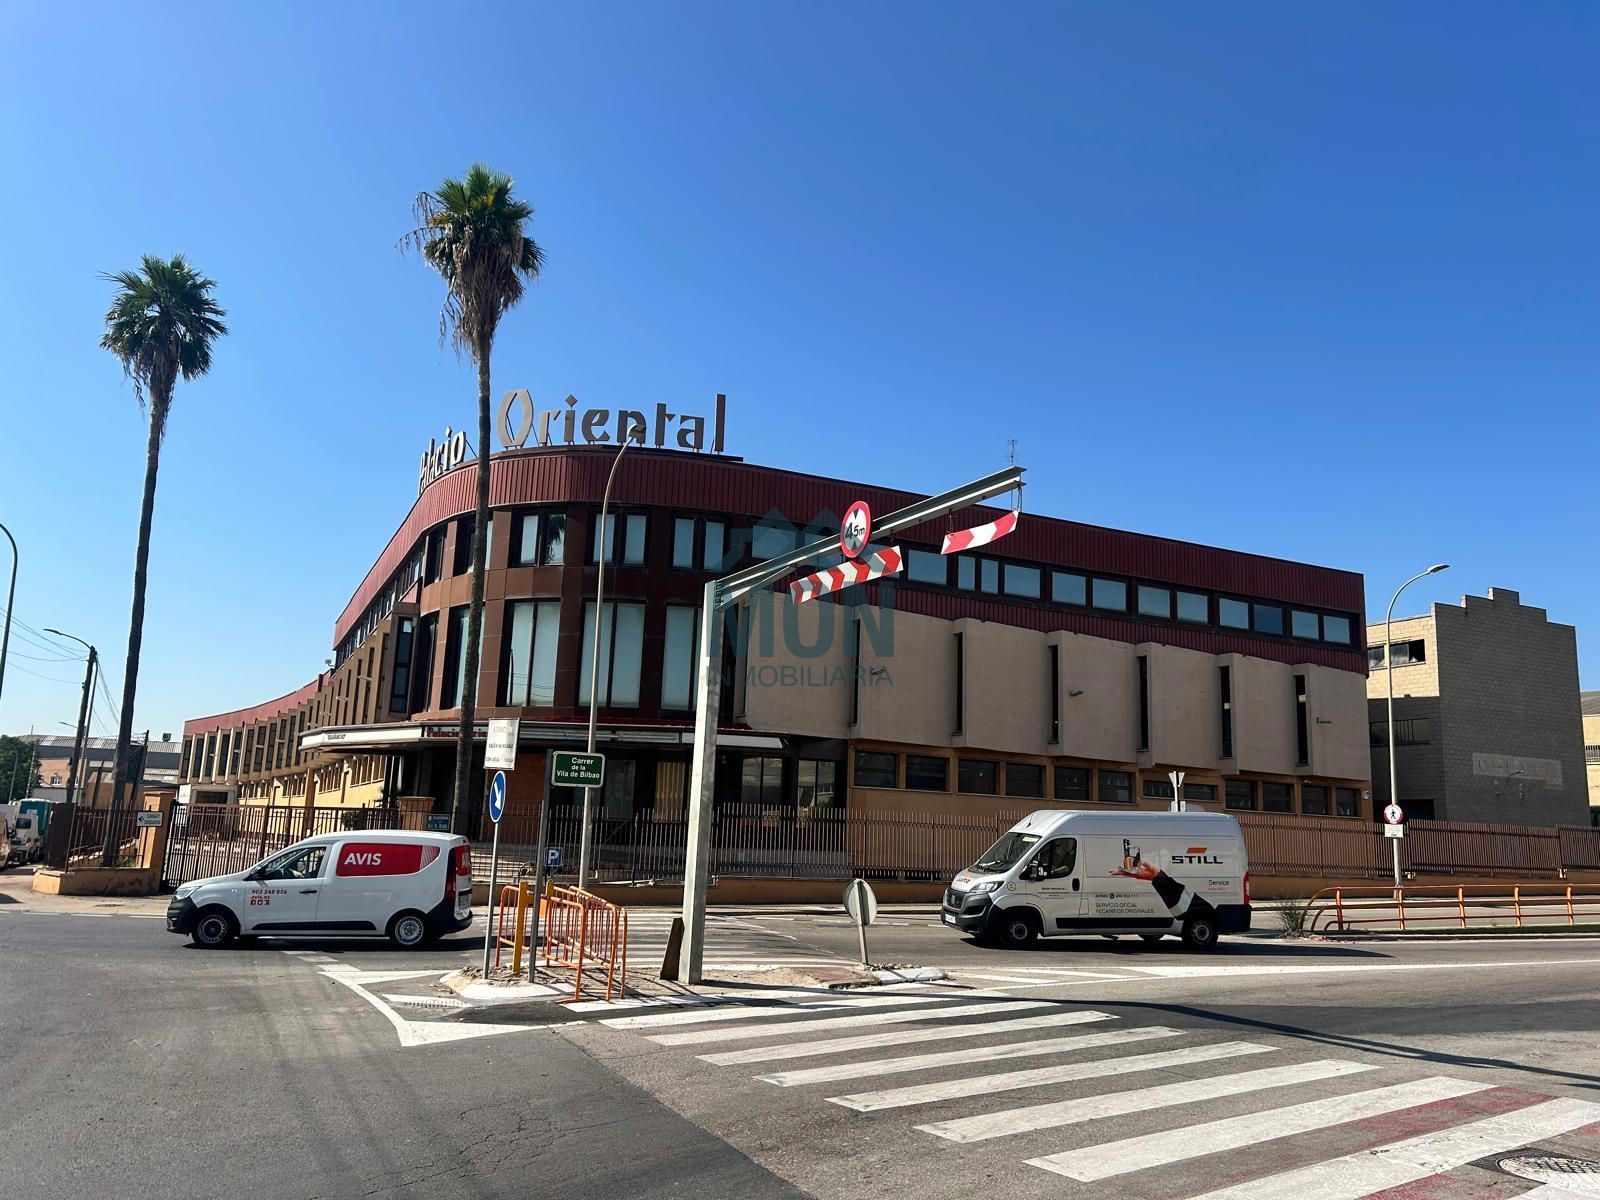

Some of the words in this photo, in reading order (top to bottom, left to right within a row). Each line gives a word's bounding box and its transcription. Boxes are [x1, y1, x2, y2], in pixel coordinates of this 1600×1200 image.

[497, 389, 726, 453] Oriental
[571, 757, 594, 765] Carrer
[580, 771, 600, 779] Bilbao
[344, 853, 382, 866] AVIS
[548, 849, 559, 865] P
[1171, 855, 1224, 865] STILL
